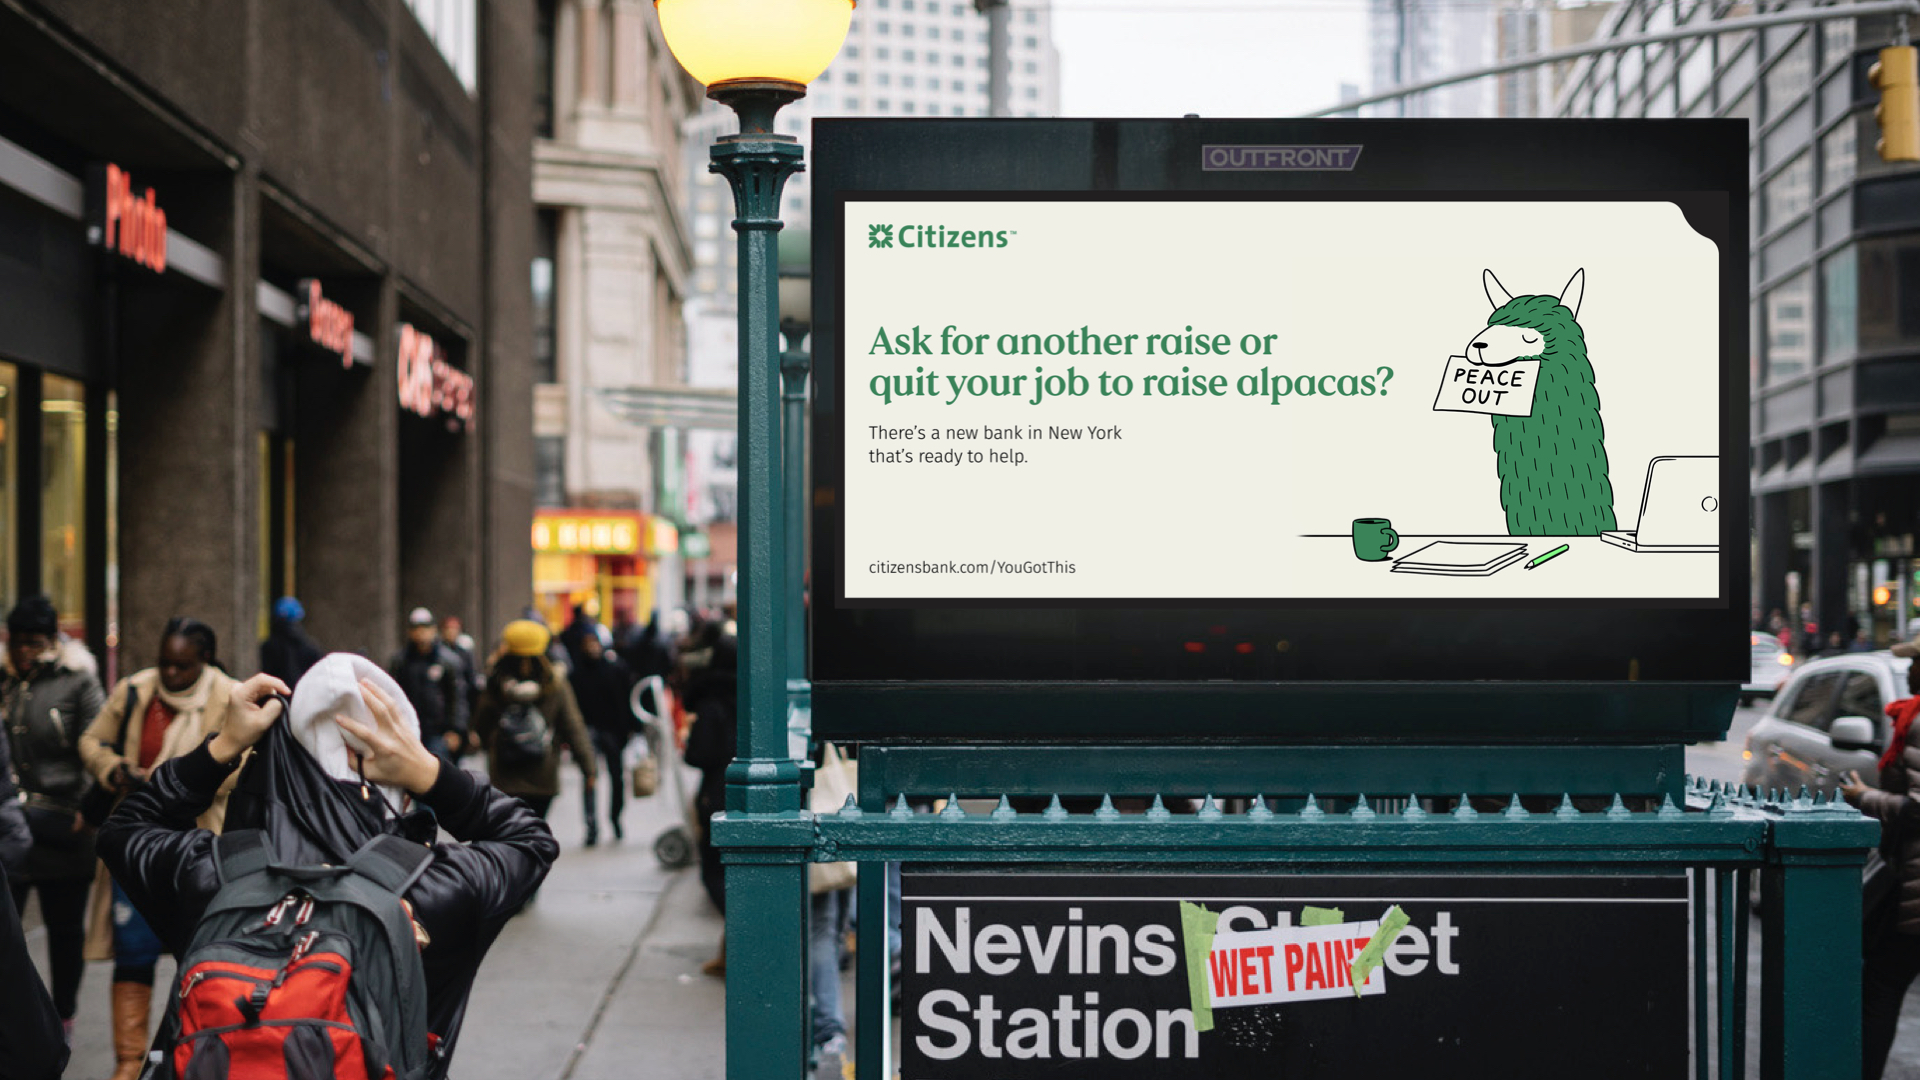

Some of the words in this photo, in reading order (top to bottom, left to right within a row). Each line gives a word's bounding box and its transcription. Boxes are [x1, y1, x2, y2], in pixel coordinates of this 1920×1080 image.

[1209, 148, 1350, 167] OUTFRONT
[868, 325, 934, 356] Ask
[941, 325, 991, 356] for
[996, 325, 1139, 356] another
[1146, 325, 1232, 356] raise
[1239, 333, 1279, 356] or
[869, 365, 941, 406] quit
[945, 368, 1027, 406] your
[1028, 365, 1090, 406] job
[1098, 370, 1134, 397] to
[1142, 365, 1229, 397] raise
[1236, 365, 1395, 406] alpacas?
[1453, 368, 1526, 388] PEACE
[1461, 387, 1510, 406] OUT
[868, 424, 926, 440] There’s
[930, 428, 941, 440] a
[946, 428, 979, 440] new
[983, 424, 1024, 440] bank
[1028, 424, 1043, 440] in
[1048, 425, 1083, 440] New
[1087, 424, 1123, 440] York
[868, 448, 914, 464] that’s
[919, 448, 964, 467] ready
[967, 449, 984, 464] to
[989, 448, 1028, 467] help.
[868, 559, 1077, 575] citizensbank.com/YouGotThis
[915, 906, 1177, 977] Nevins
[1209, 945, 1275, 998] WET
[915, 989, 1200, 1061] Station
